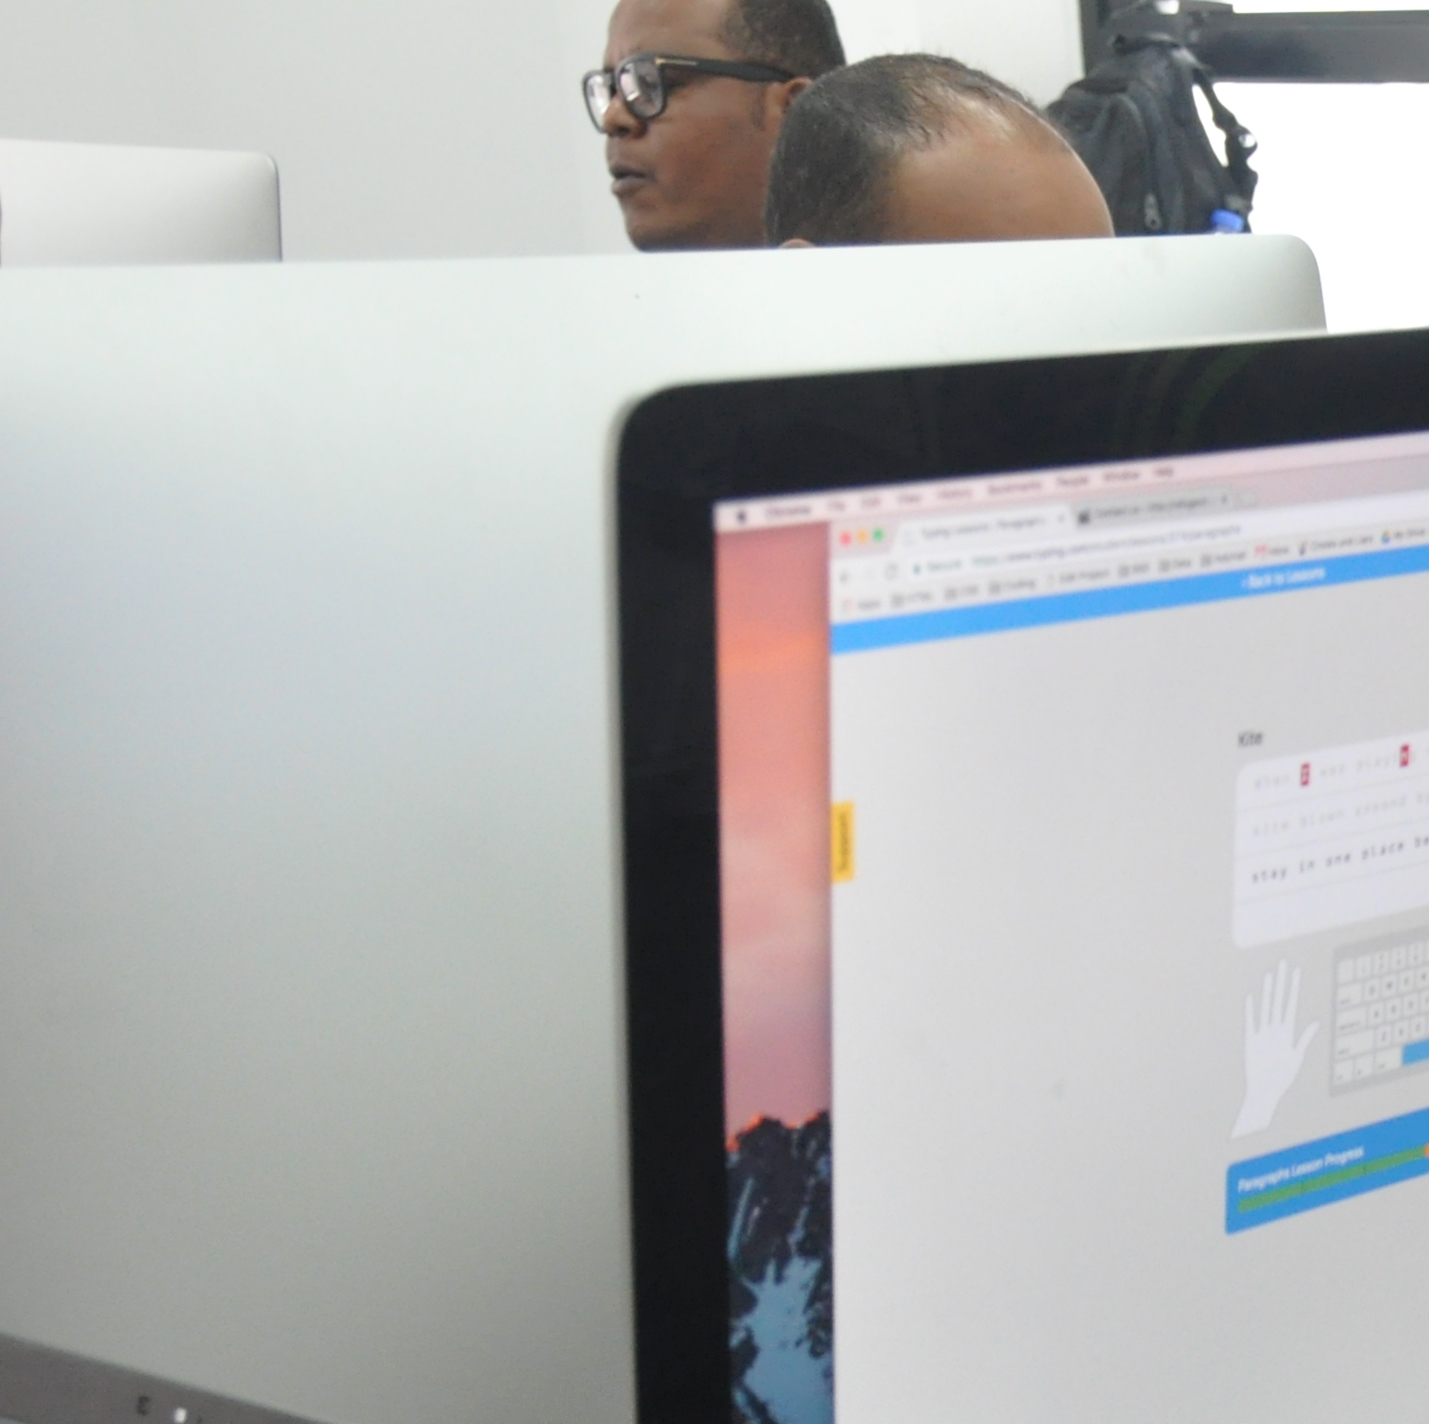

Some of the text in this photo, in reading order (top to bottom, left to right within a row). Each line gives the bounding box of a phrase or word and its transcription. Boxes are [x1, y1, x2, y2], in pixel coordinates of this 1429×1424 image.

[1237, 730, 1265, 748] Kite
[1252, 867, 1288, 885] stay
[1299, 860, 1316, 875] in
[1325, 853, 1352, 869] one
[1361, 841, 1405, 861] place
[1238, 1145, 1365, 1193] Paragraphs Lesson Progress
